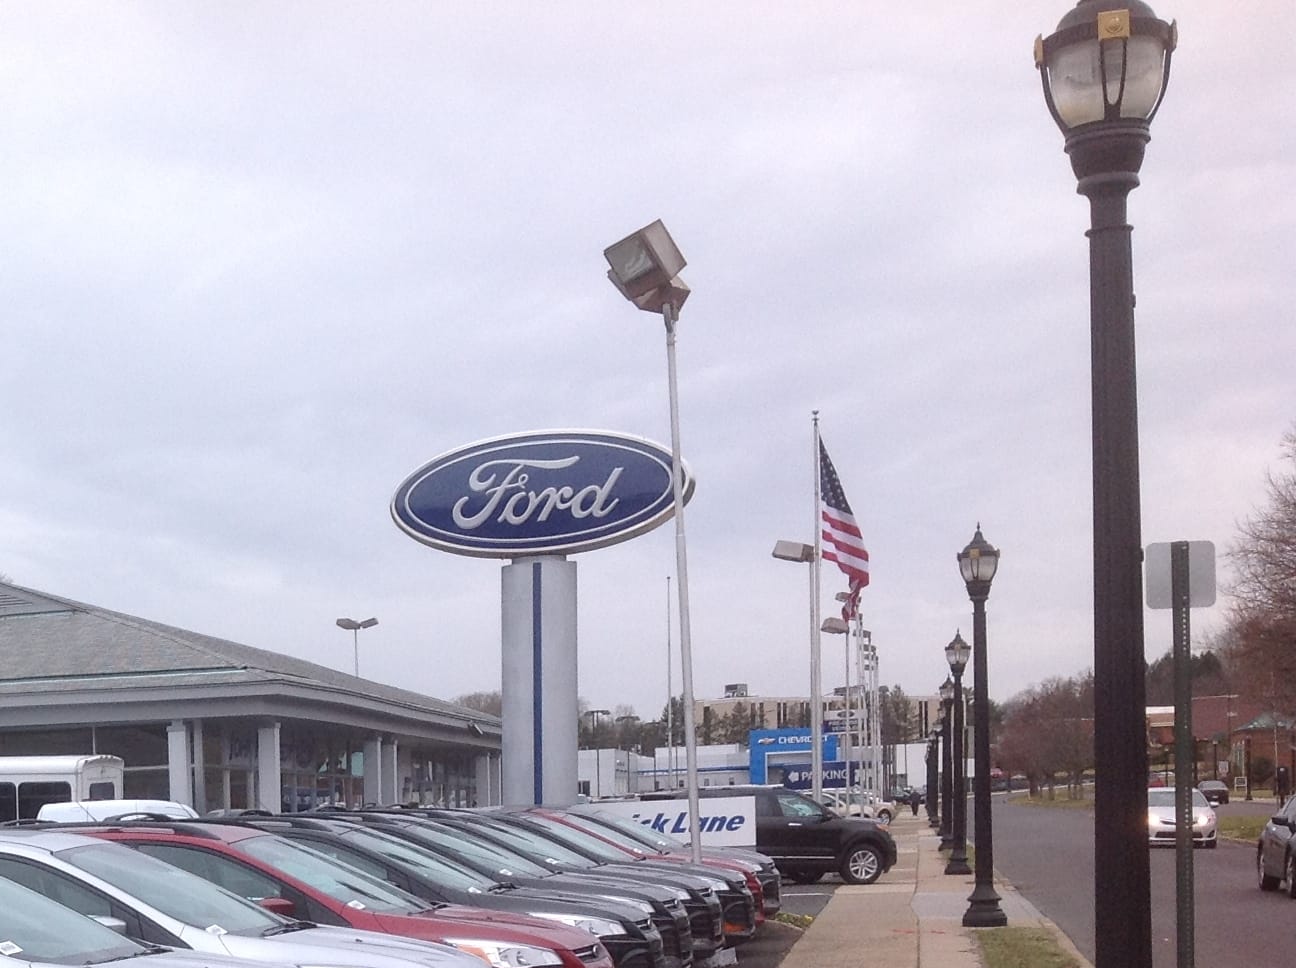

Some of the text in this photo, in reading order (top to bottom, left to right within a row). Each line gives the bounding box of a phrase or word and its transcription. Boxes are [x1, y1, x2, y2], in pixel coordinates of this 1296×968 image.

[453, 455, 624, 529] Ford
[778, 734, 828, 744] CHEVROT
[801, 769, 849, 781] PAKING
